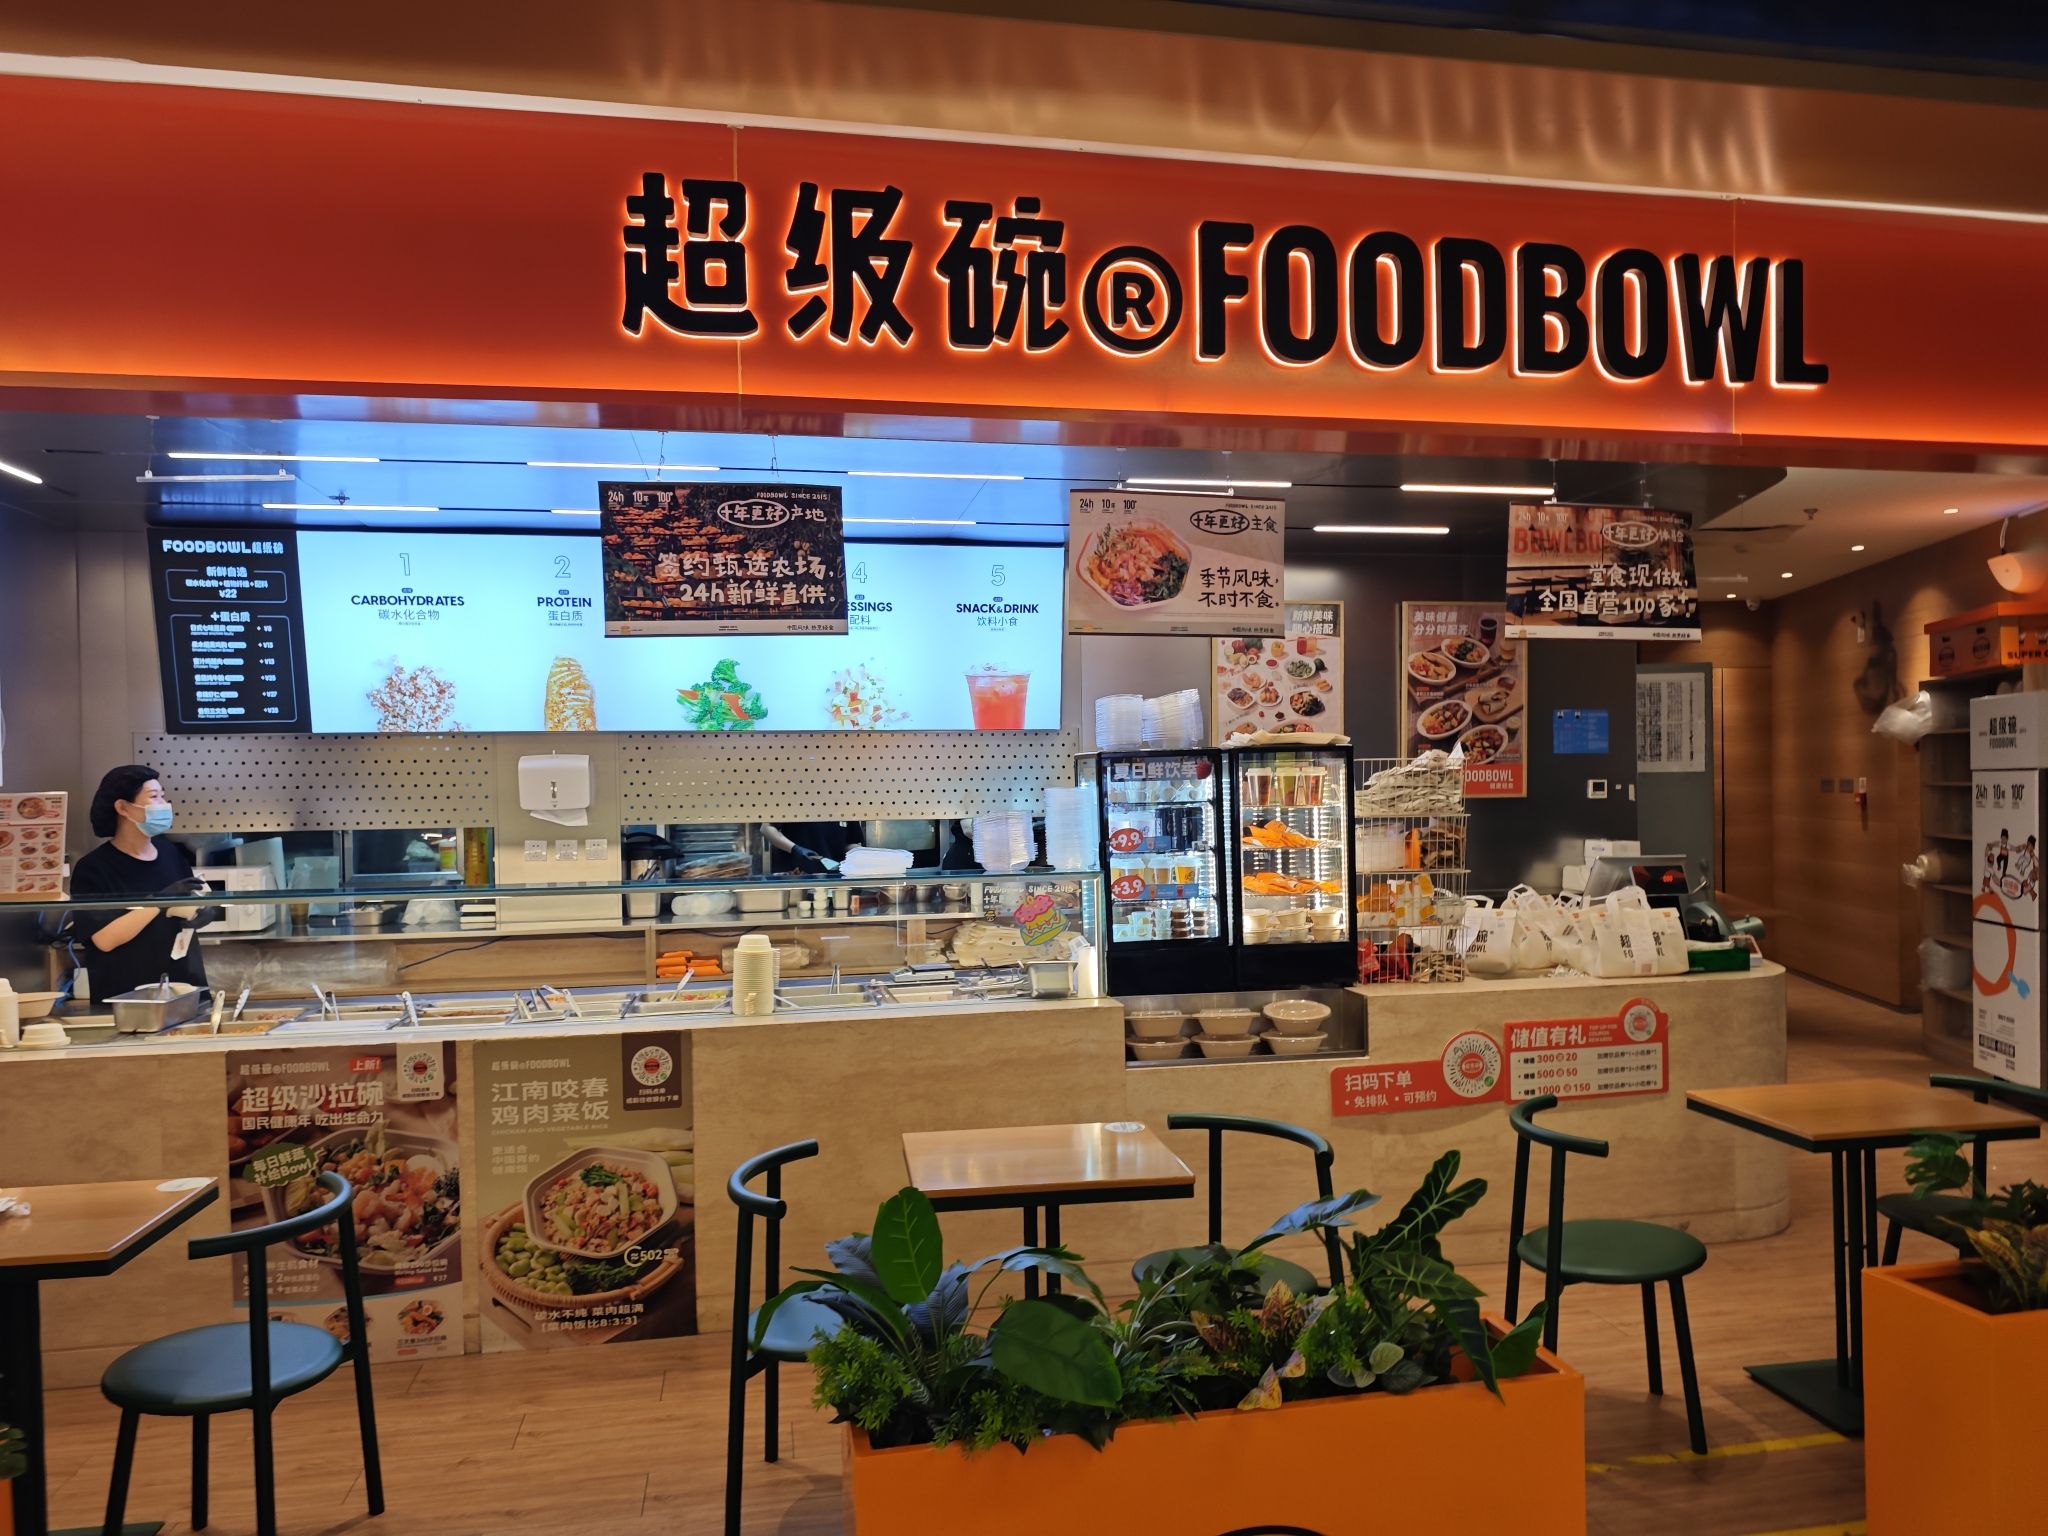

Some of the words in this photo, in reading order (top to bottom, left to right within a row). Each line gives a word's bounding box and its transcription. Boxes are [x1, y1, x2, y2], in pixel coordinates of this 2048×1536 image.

[1196, 220, 1829, 389] FOODBOWL
[791, 492, 811, 500] SINCE
[1251, 515, 1278, 534] 主食
[351, 595, 465, 607] CARBOHYDRATES
[537, 596, 592, 608] PROTEIN
[378, 609, 440, 621] 碳水化合物
[547, 610, 584, 621] 蛋白质
[849, 614, 870, 625] 配料
[1345, 1070, 1413, 1092] 扫码下单
[241, 1081, 384, 1113] 超级沙拉碗
[491, 1077, 609, 1103] 江南咬春
[1403, 1089, 1437, 1105] 可预约
[491, 1100, 610, 1126] 鸡肉菜饭
